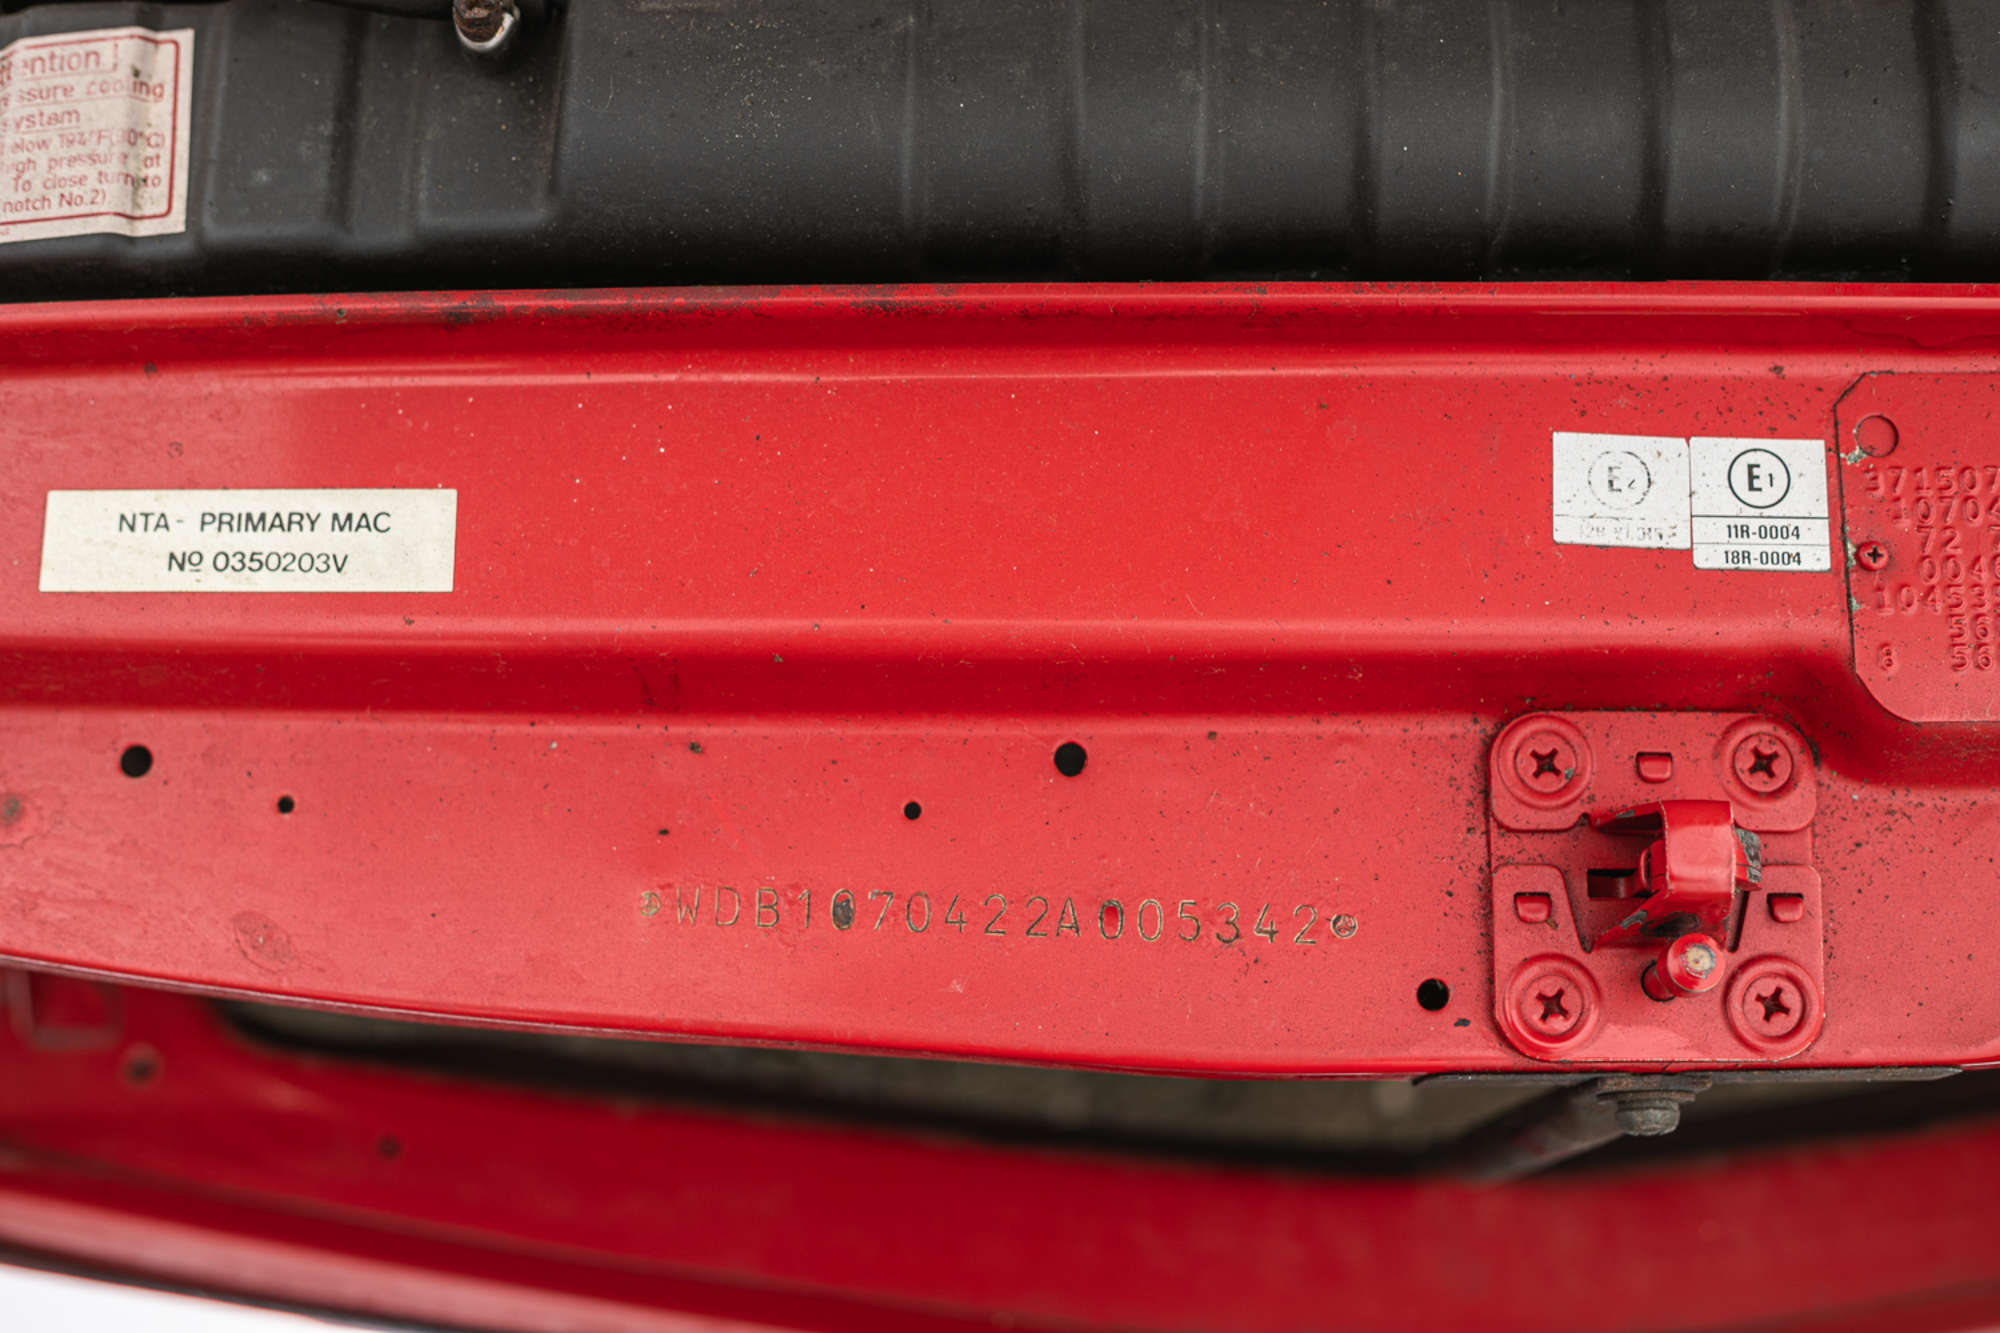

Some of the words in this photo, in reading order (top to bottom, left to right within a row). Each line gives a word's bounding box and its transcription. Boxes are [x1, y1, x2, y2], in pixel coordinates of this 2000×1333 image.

[43, 173, 89, 191] close
[2, 194, 52, 214] notch
[199, 511, 322, 534] PRIMARY
[330, 511, 392, 534] MAC
[1725, 523, 1801, 541] 11R-0004
[212, 551, 349, 574] 0350203V
[1723, 549, 1803, 567] 18R-0004
[676, 885, 1318, 945] WDB1070422A005342
